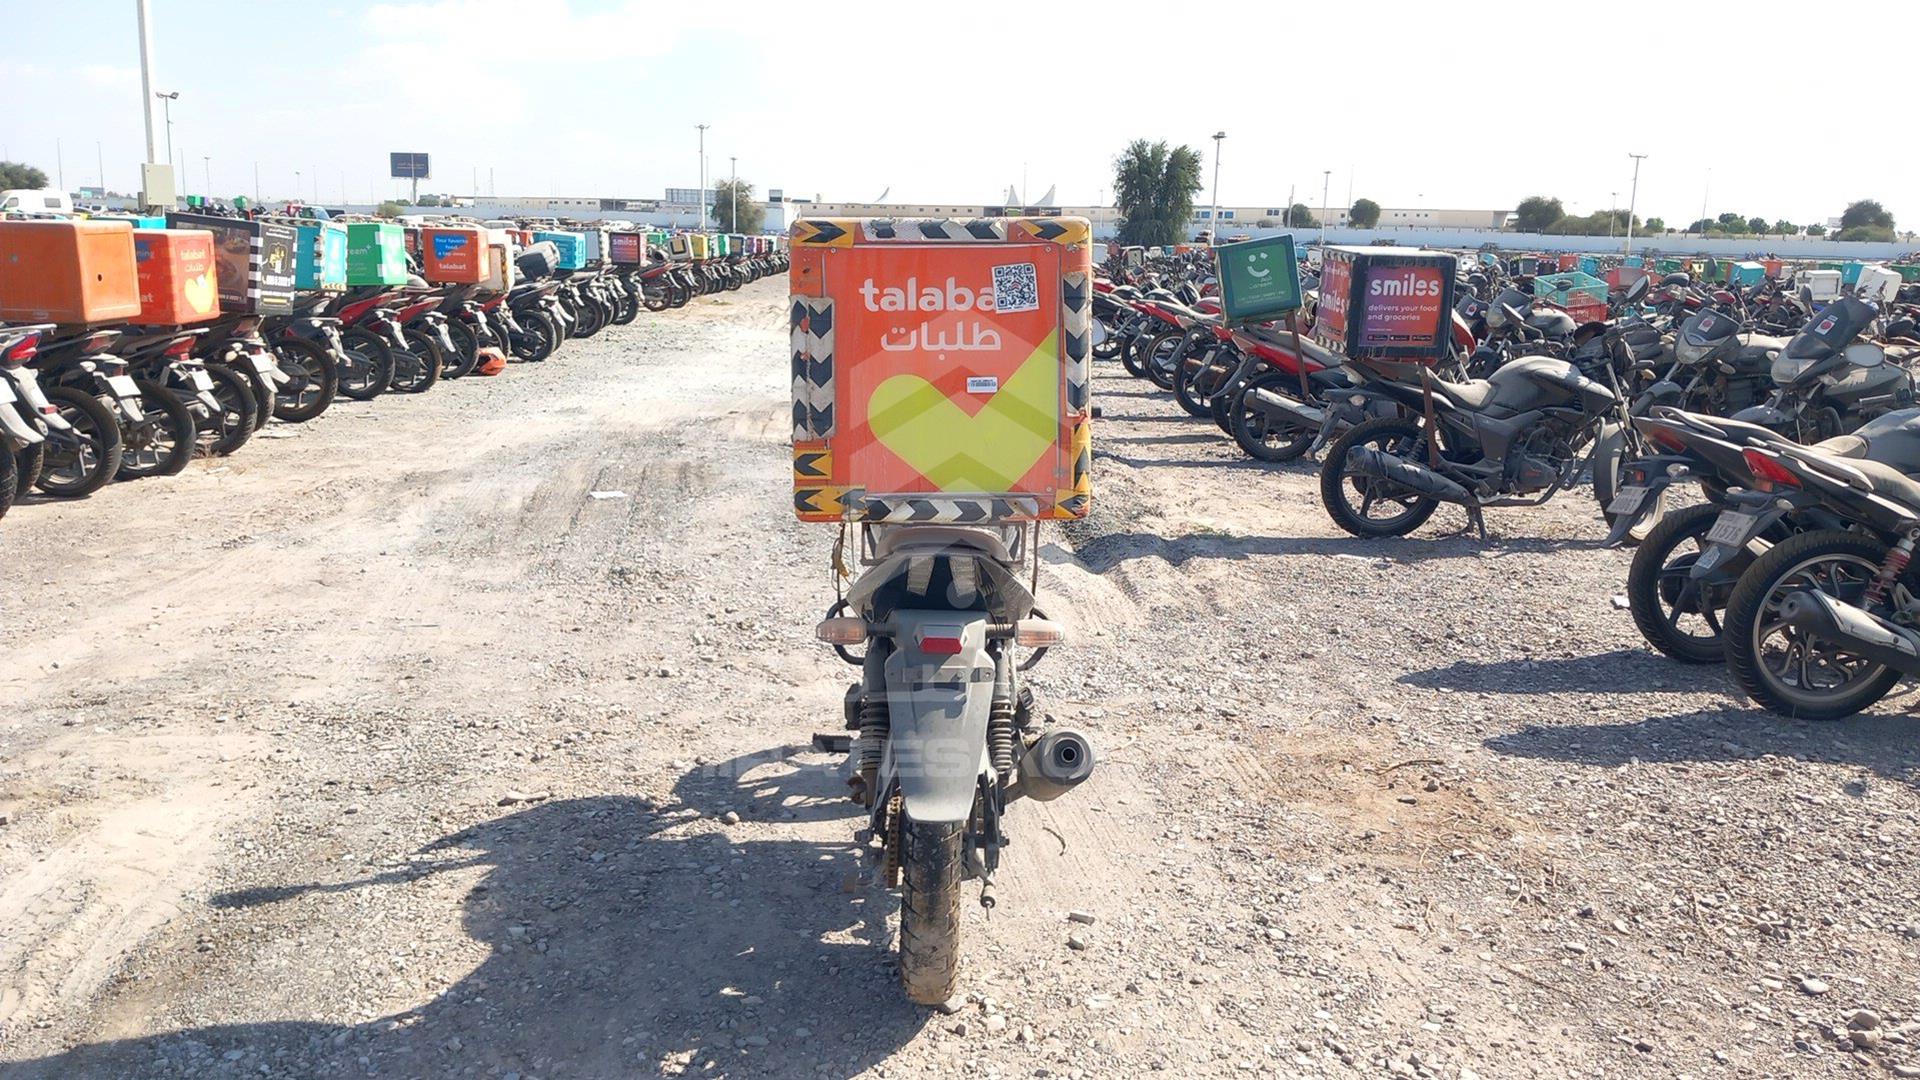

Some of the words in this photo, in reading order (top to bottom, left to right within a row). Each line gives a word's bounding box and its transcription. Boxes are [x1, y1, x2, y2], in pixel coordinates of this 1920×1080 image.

[613, 237, 637, 246] smiles
[858, 276, 995, 312] talaba
[1370, 273, 1439, 296] smiles
[1320, 290, 1345, 314] smiles
[1368, 304, 1399, 312] delivers
[1420, 304, 1438, 312] food
[1384, 313, 1421, 322] groceries
[880, 321, 1002, 361] طلبات
